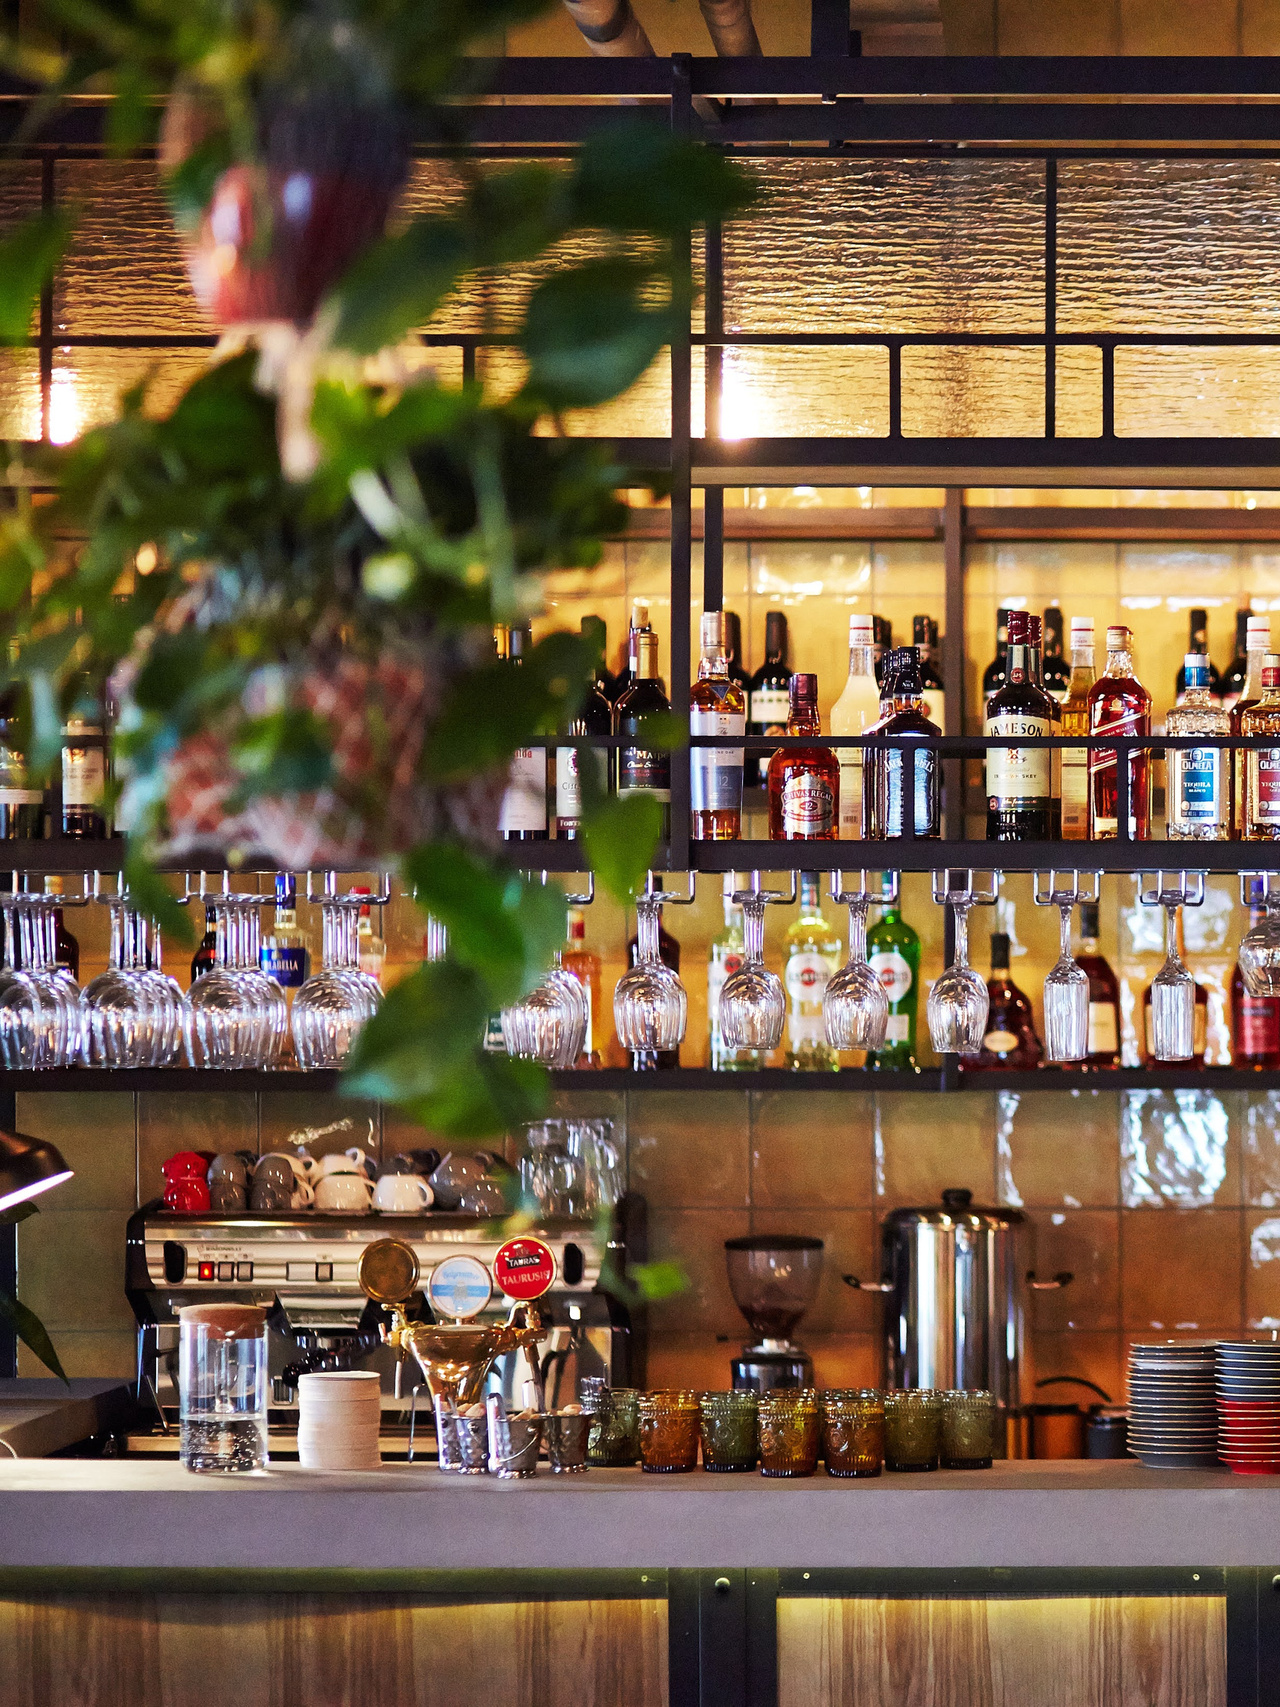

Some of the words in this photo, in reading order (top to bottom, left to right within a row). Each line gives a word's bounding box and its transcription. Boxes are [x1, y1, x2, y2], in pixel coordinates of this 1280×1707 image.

[990, 722, 1044, 737] JAMESON
[1182, 760, 1213, 770] OLMECA
[718, 775, 730, 787] 12
[1183, 781, 1211, 789] TEQUILA
[784, 789, 811, 802] CHIVAS
[811, 788, 833, 802] REGAL
[804, 802, 814, 811] 12
[509, 1256, 537, 1268] TAURAS
